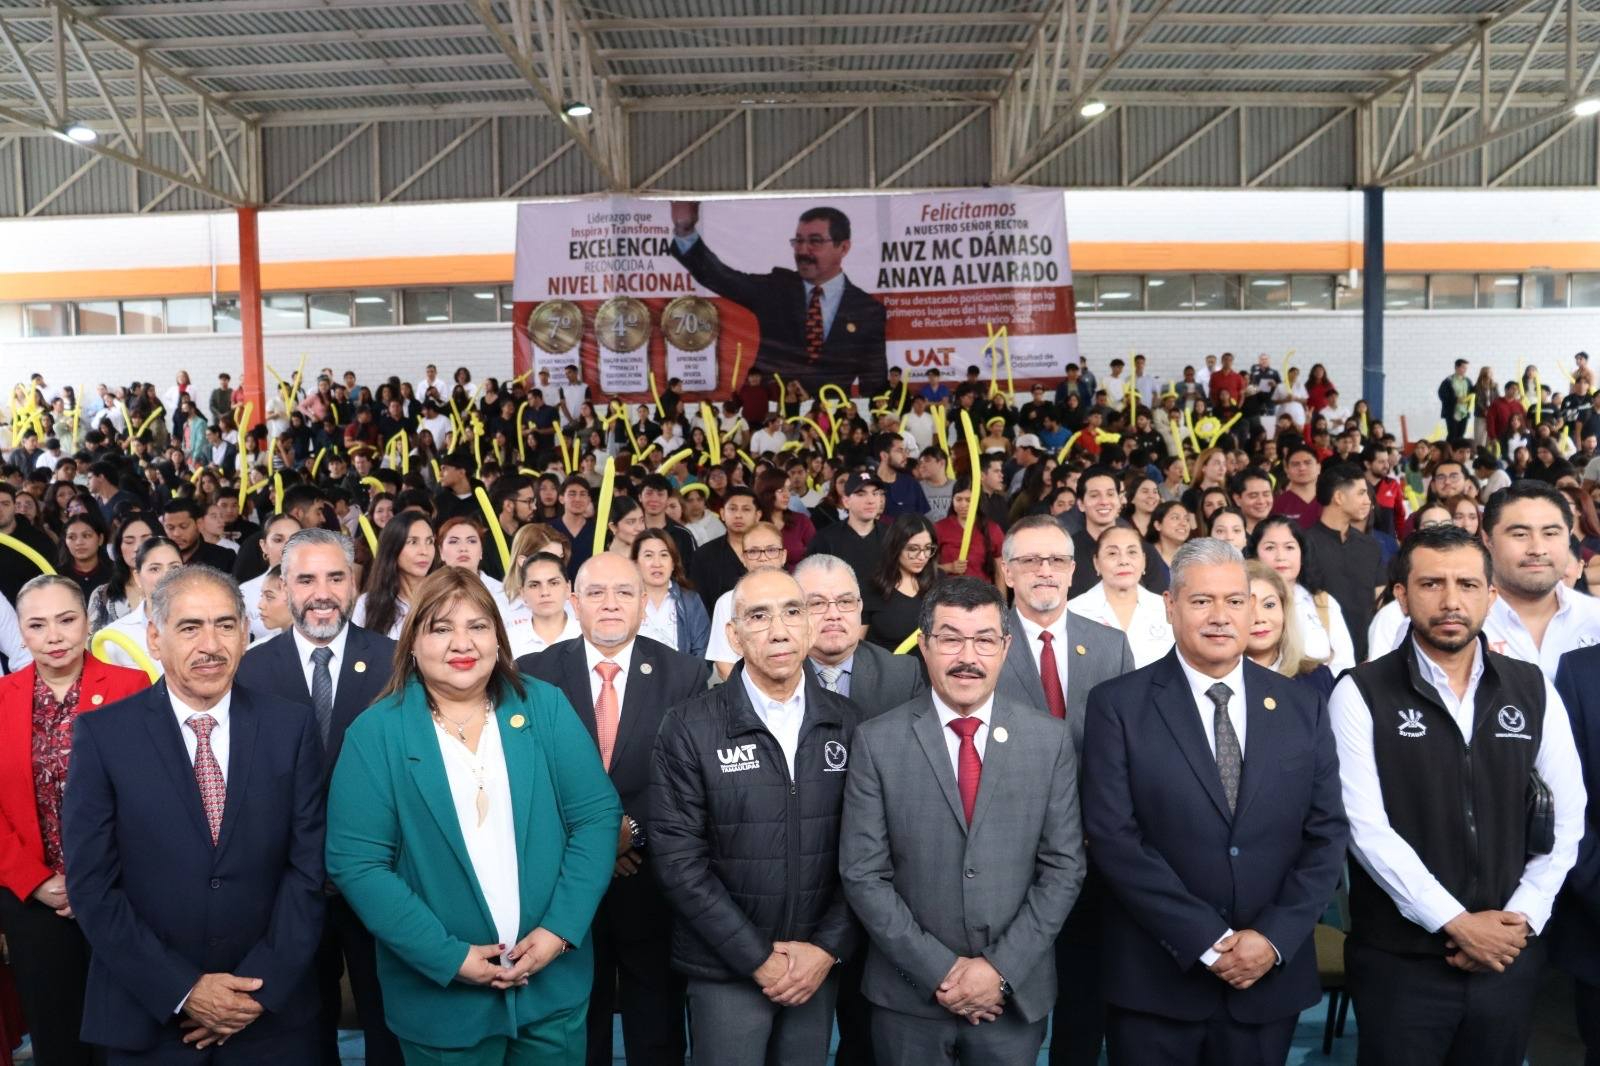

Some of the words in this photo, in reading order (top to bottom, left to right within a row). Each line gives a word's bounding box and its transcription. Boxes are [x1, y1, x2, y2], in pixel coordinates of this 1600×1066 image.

[587, 212, 632, 225] Liderazgo
[634, 214, 652, 224] que
[921, 202, 1016, 222] Felicitamos
[571, 227, 602, 239] Inspira
[604, 229, 609, 239] y
[611, 224, 670, 235] Transforma
[905, 226, 912, 236] A
[914, 224, 958, 235] NUESTRO
[960, 220, 993, 232] SEÑOR
[995, 219, 1028, 230] RECTOR
[570, 238, 671, 259] EXCELENCIA
[881, 240, 926, 263] MVZ
[932, 238, 963, 259] MC
[970, 230, 1052, 256] DÁMASO
[584, 260, 644, 272] RECONOCIDA
[645, 260, 654, 271] A
[877, 267, 946, 288] ANAYA
[953, 260, 1058, 284] ALVARADO
[548, 276, 598, 295] NIVEL
[603, 272, 696, 292] NACIONAL
[884, 296, 898, 305] Por
[912, 295, 958, 305] destacado
[886, 308, 926, 319] primeros
[928, 305, 960, 319] lugares
[962, 304, 975, 314] del
[978, 304, 1014, 316] Ranking
[673, 314, 711, 334] 70%
[912, 318, 923, 328] de
[924, 317, 963, 327] Rectores
[964, 316, 976, 326] de
[978, 314, 1009, 325] México
[906, 348, 954, 367] UAT
[717, 744, 756, 764] UAT
[722, 764, 760, 773] TAMAULIPAS
